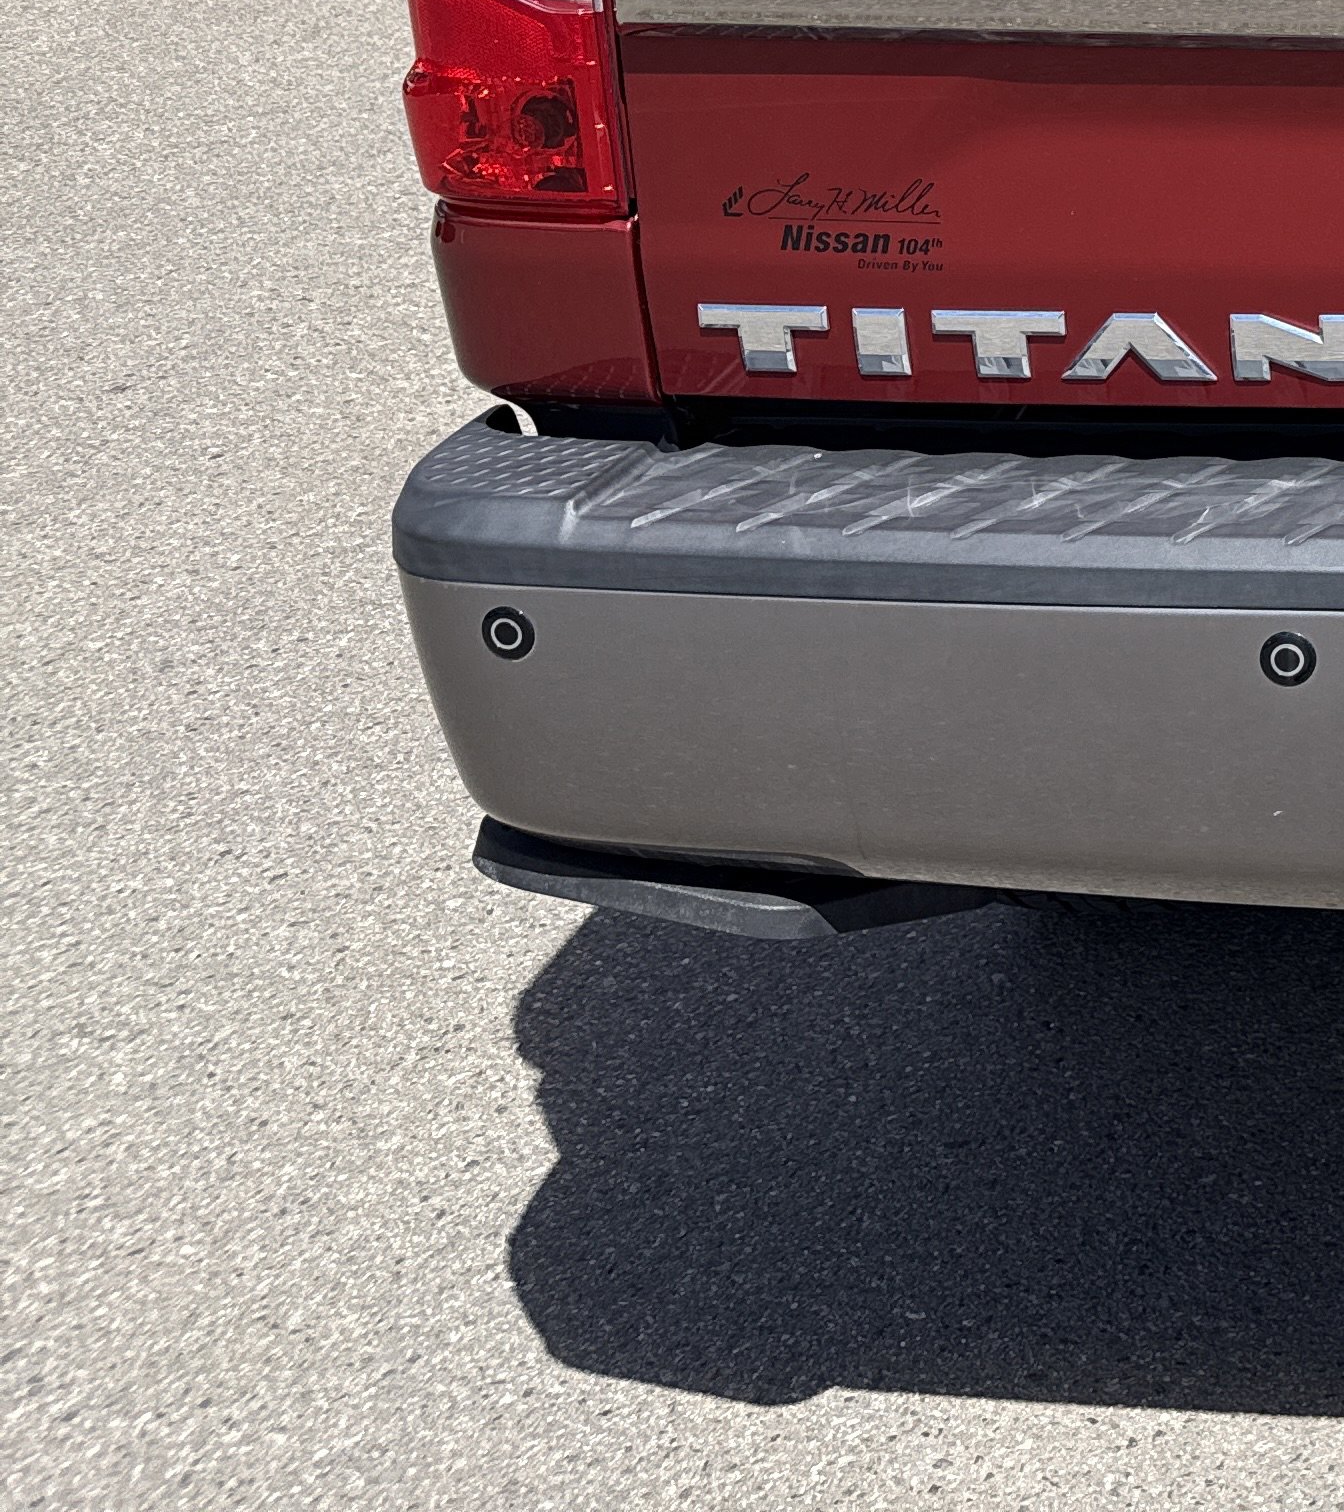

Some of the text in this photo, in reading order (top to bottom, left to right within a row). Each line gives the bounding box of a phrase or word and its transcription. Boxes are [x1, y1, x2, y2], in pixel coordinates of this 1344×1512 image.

[748, 172, 825, 221] Larry
[851, 178, 942, 219] Miller
[780, 224, 943, 256] Nissan 104th
[857, 258, 944, 273] Driven By You
